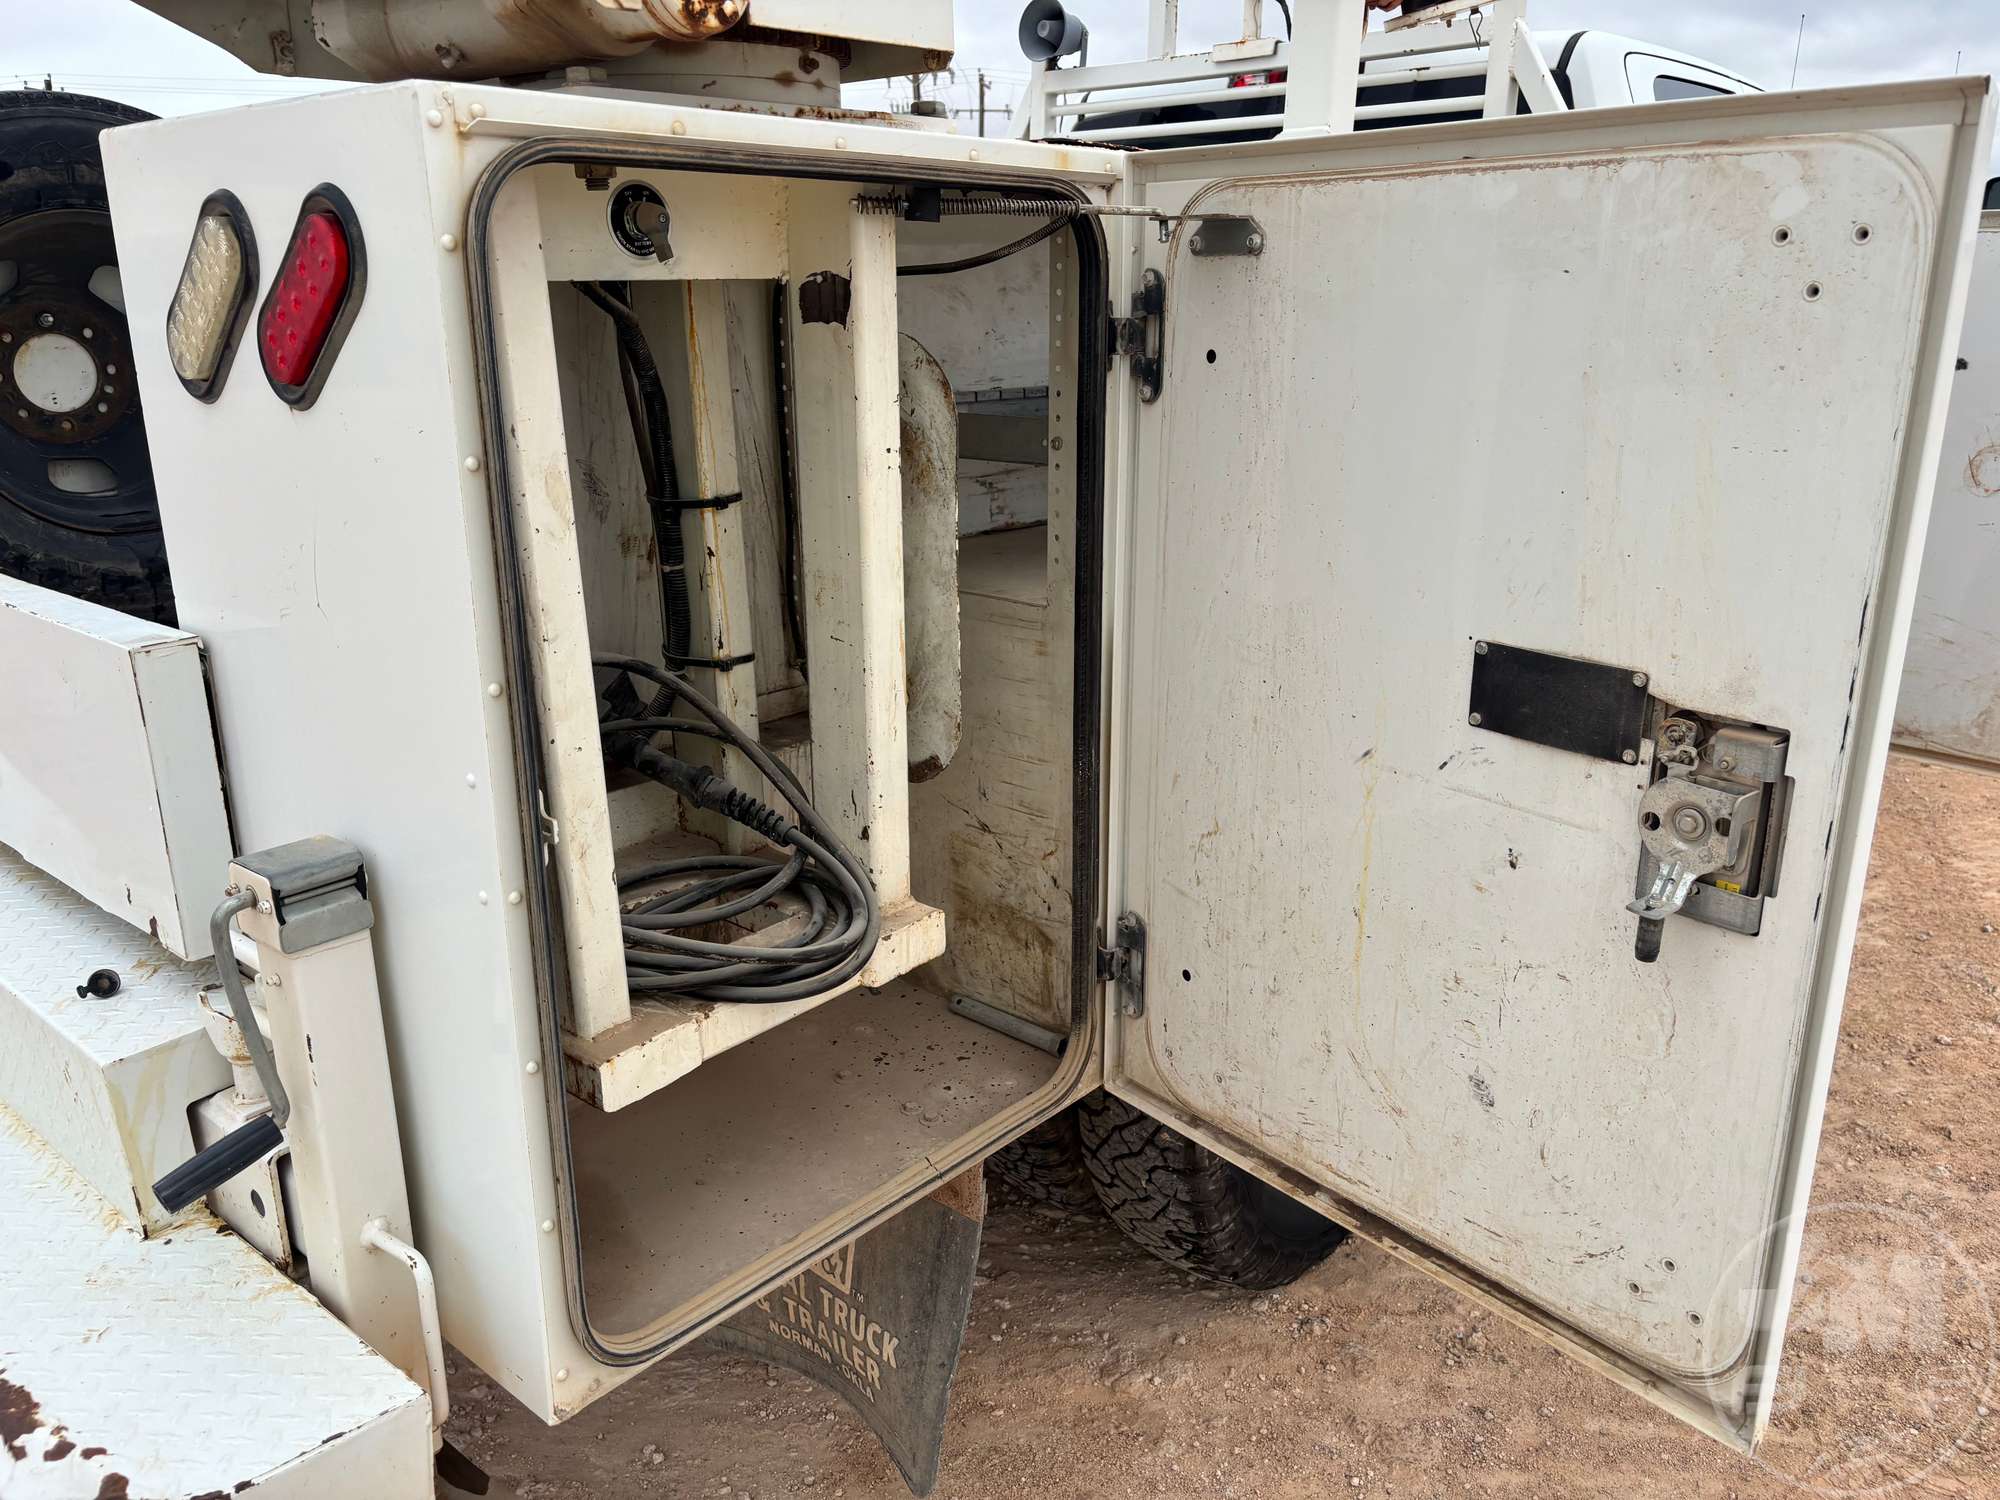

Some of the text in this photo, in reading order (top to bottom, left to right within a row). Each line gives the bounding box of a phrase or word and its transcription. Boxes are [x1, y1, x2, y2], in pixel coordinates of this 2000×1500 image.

[819, 1286, 900, 1369] TRUCK
[852, 1289, 864, 1303] TM
[783, 1296, 881, 1391] TRAILER
